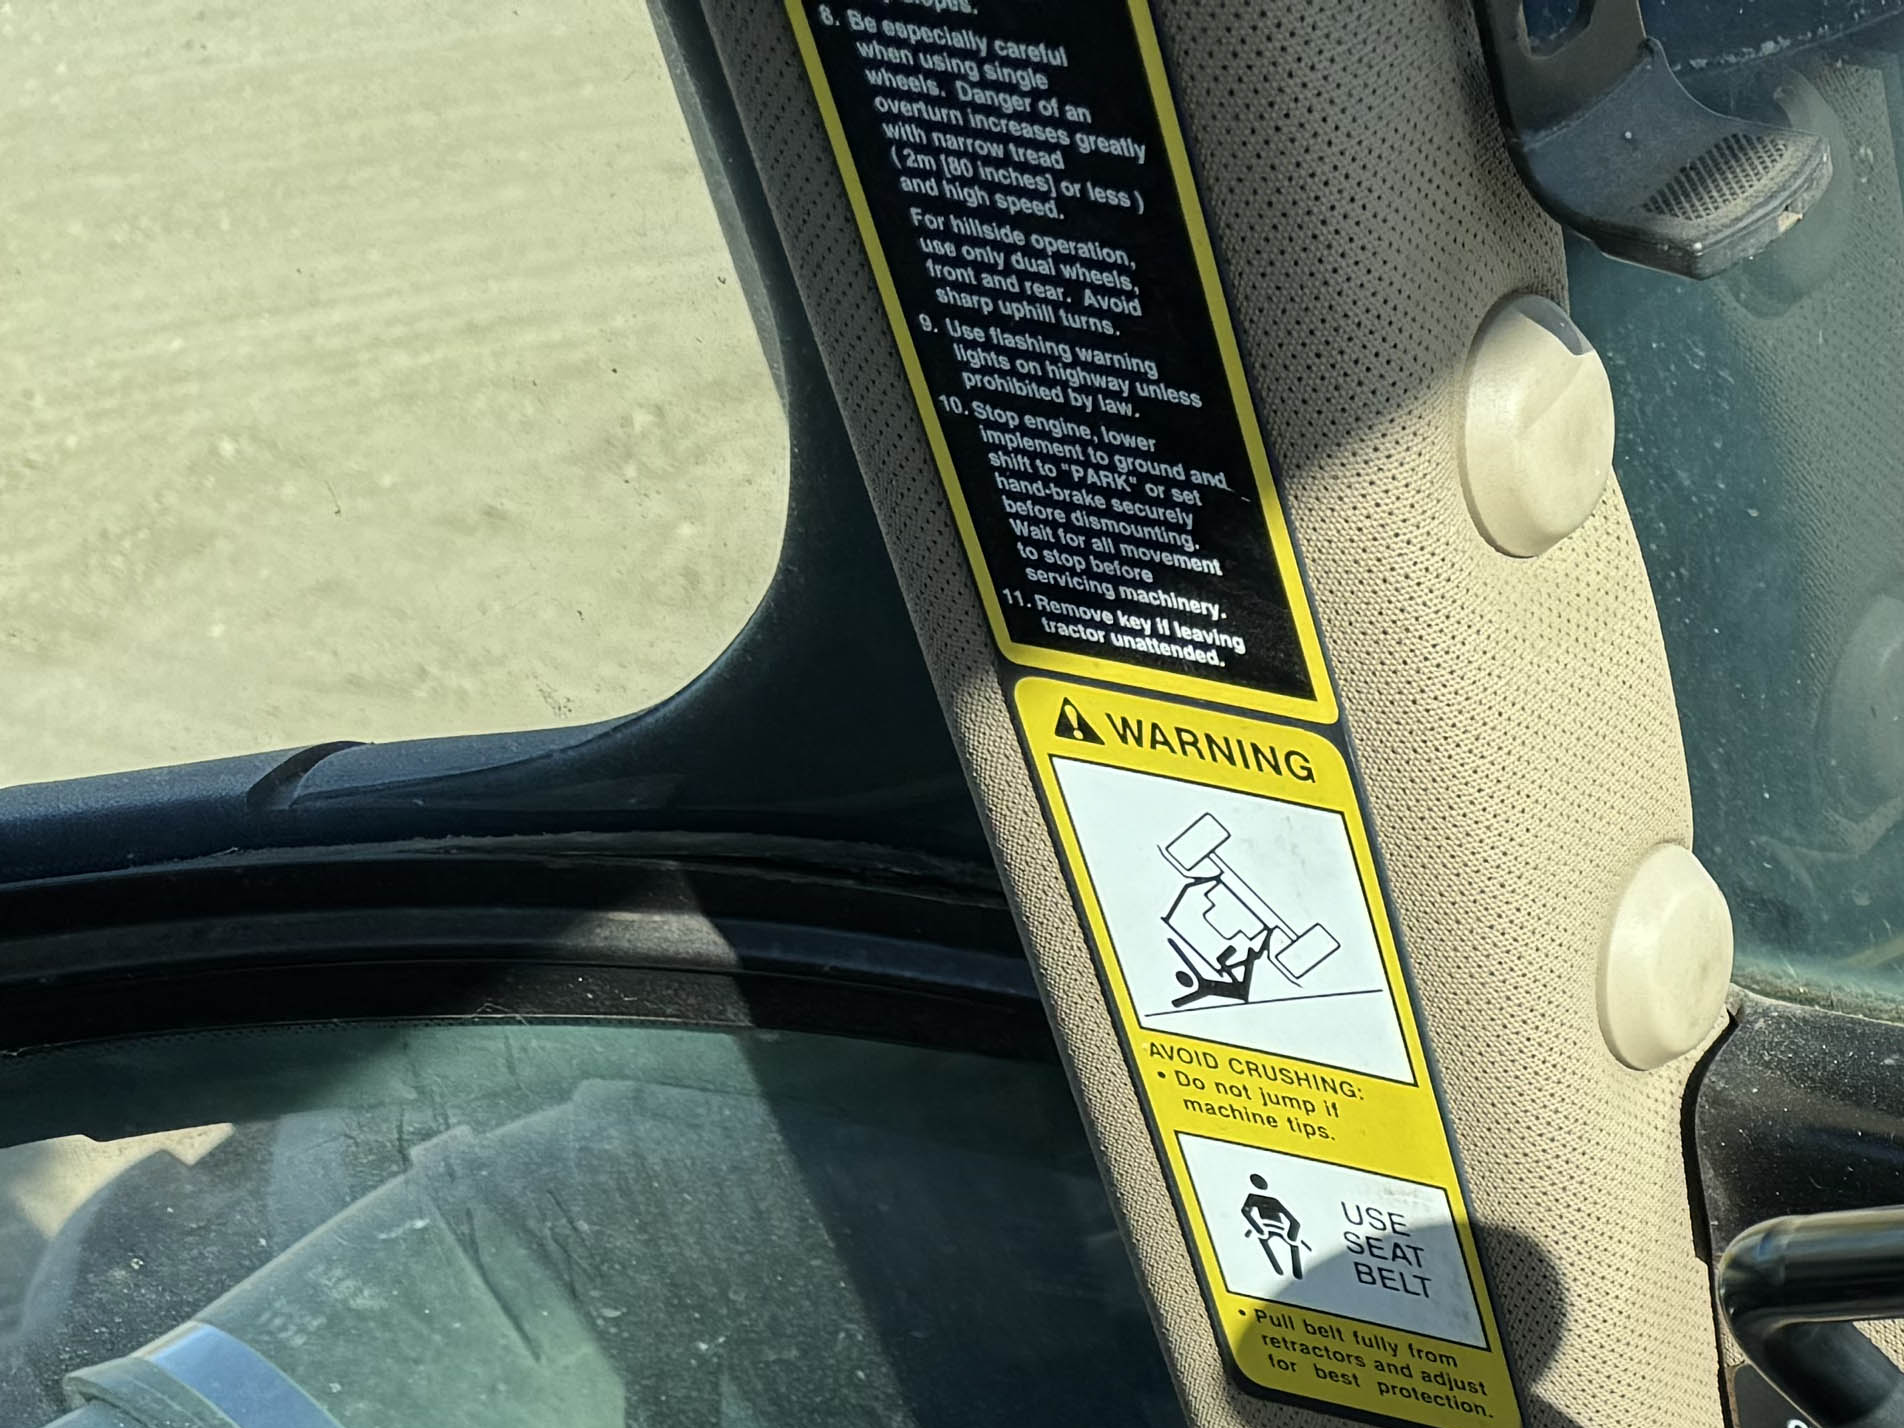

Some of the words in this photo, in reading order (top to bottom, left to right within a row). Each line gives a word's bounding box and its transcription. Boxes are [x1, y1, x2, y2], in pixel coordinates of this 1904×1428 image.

[918, 312, 938, 333] 9.
[944, 317, 985, 342] Use
[988, 325, 1073, 363] flashing
[1074, 346, 1158, 380] warning
[952, 342, 1011, 370] lights
[1014, 358, 1042, 376] on
[1044, 359, 1129, 397] highway
[1134, 381, 1202, 408] unless
[961, 371, 1064, 403] prohibited
[1066, 387, 1092, 413] by
[1097, 393, 1140, 418] law.
[1001, 587, 1031, 608] 11.
[1033, 593, 1114, 624] Remove
[1116, 609, 1151, 635] key
[1154, 616, 1170, 636] if
[1172, 620, 1246, 654] leaving
[1040, 616, 1105, 643] tractor
[1109, 631, 1226, 667] unattended.
[1106, 713, 1316, 783] WARNING
[1149, 1041, 1219, 1069] AVOID
[1227, 1056, 1364, 1100] CRUSHING:
[1173, 1069, 1206, 1090] Do
[1213, 1080, 1252, 1100] not
[1258, 1086, 1316, 1116] jump
[1322, 1099, 1339, 1118] if
[1182, 1098, 1278, 1128] machine
[1286, 1116, 1335, 1141] tips.
[1340, 1200, 1412, 1238] USE
[1342, 1230, 1424, 1268] SEAT
[1352, 1260, 1432, 1298] BELT
[1253, 1307, 1295, 1331] Pull
[1301, 1318, 1345, 1342] belt
[1351, 1329, 1398, 1357] fully
[1407, 1342, 1458, 1368] from
[1260, 1333, 1366, 1368] retractors
[1373, 1359, 1413, 1379] and
[1419, 1369, 1488, 1396] adjust
[1267, 1352, 1297, 1373] for
[1312, 1362, 1360, 1388] best
[1376, 1380, 1494, 1418] protection.
